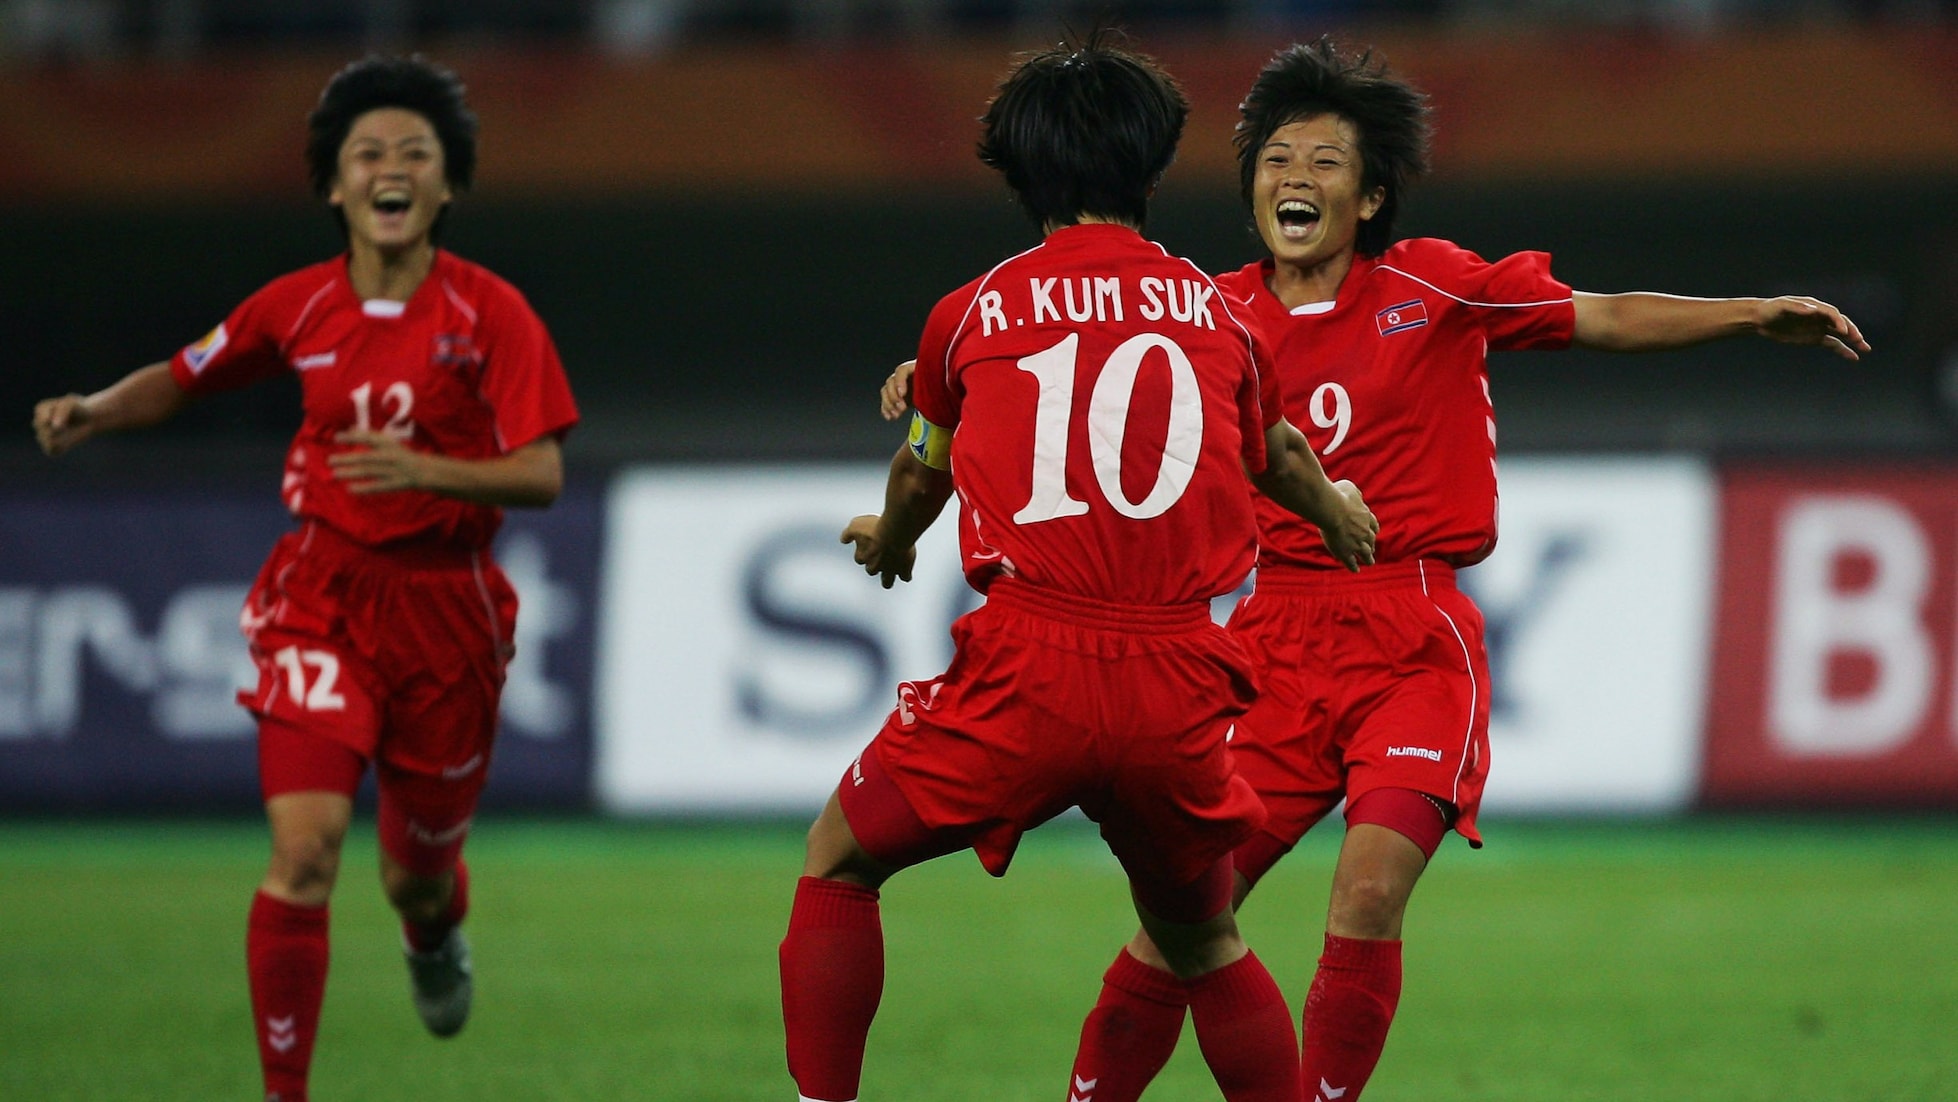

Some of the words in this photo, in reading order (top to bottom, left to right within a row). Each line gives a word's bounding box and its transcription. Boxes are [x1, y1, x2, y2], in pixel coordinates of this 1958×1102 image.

[1139, 277, 1216, 331] SUK
[350, 380, 414, 440] 12
[1013, 332, 1204, 525] 10
[1309, 382, 1352, 456] 9
[275, 645, 346, 711] 12
[1386, 746, 1442, 762] hummel
